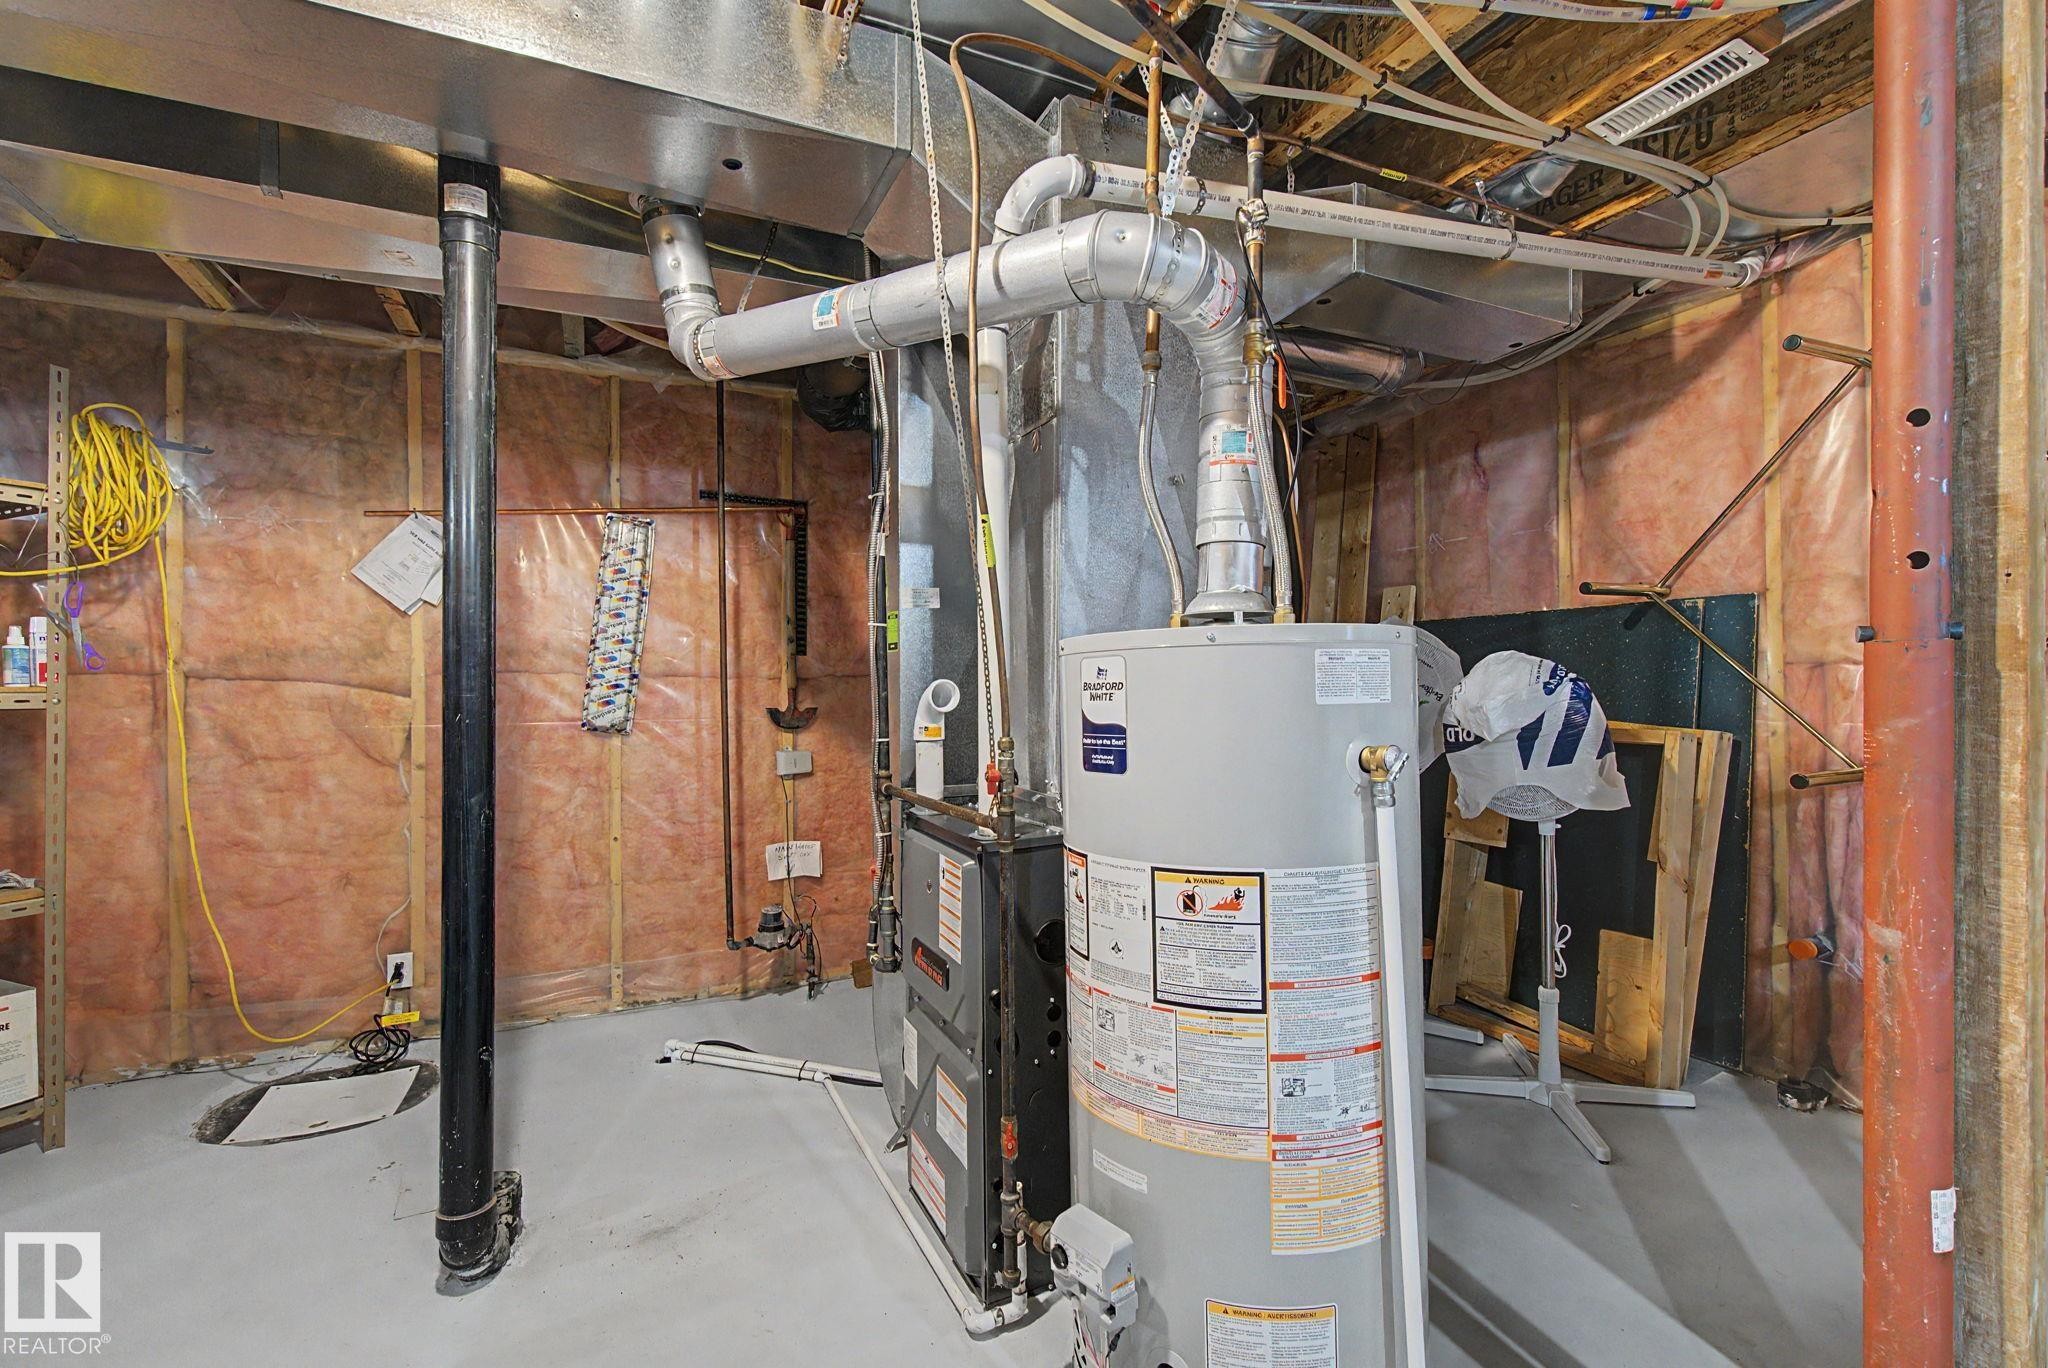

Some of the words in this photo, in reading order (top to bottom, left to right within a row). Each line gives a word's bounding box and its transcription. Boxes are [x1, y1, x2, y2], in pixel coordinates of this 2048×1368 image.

[1083, 682, 1124, 692] BRADFORD
[1089, 692, 1114, 702] WHITE
[1446, 726, 1475, 743] OLD
[1193, 877, 1225, 886] WARNING
[914, 946, 944, 986] Amana
[1232, 1310, 1263, 1319] WARNING
